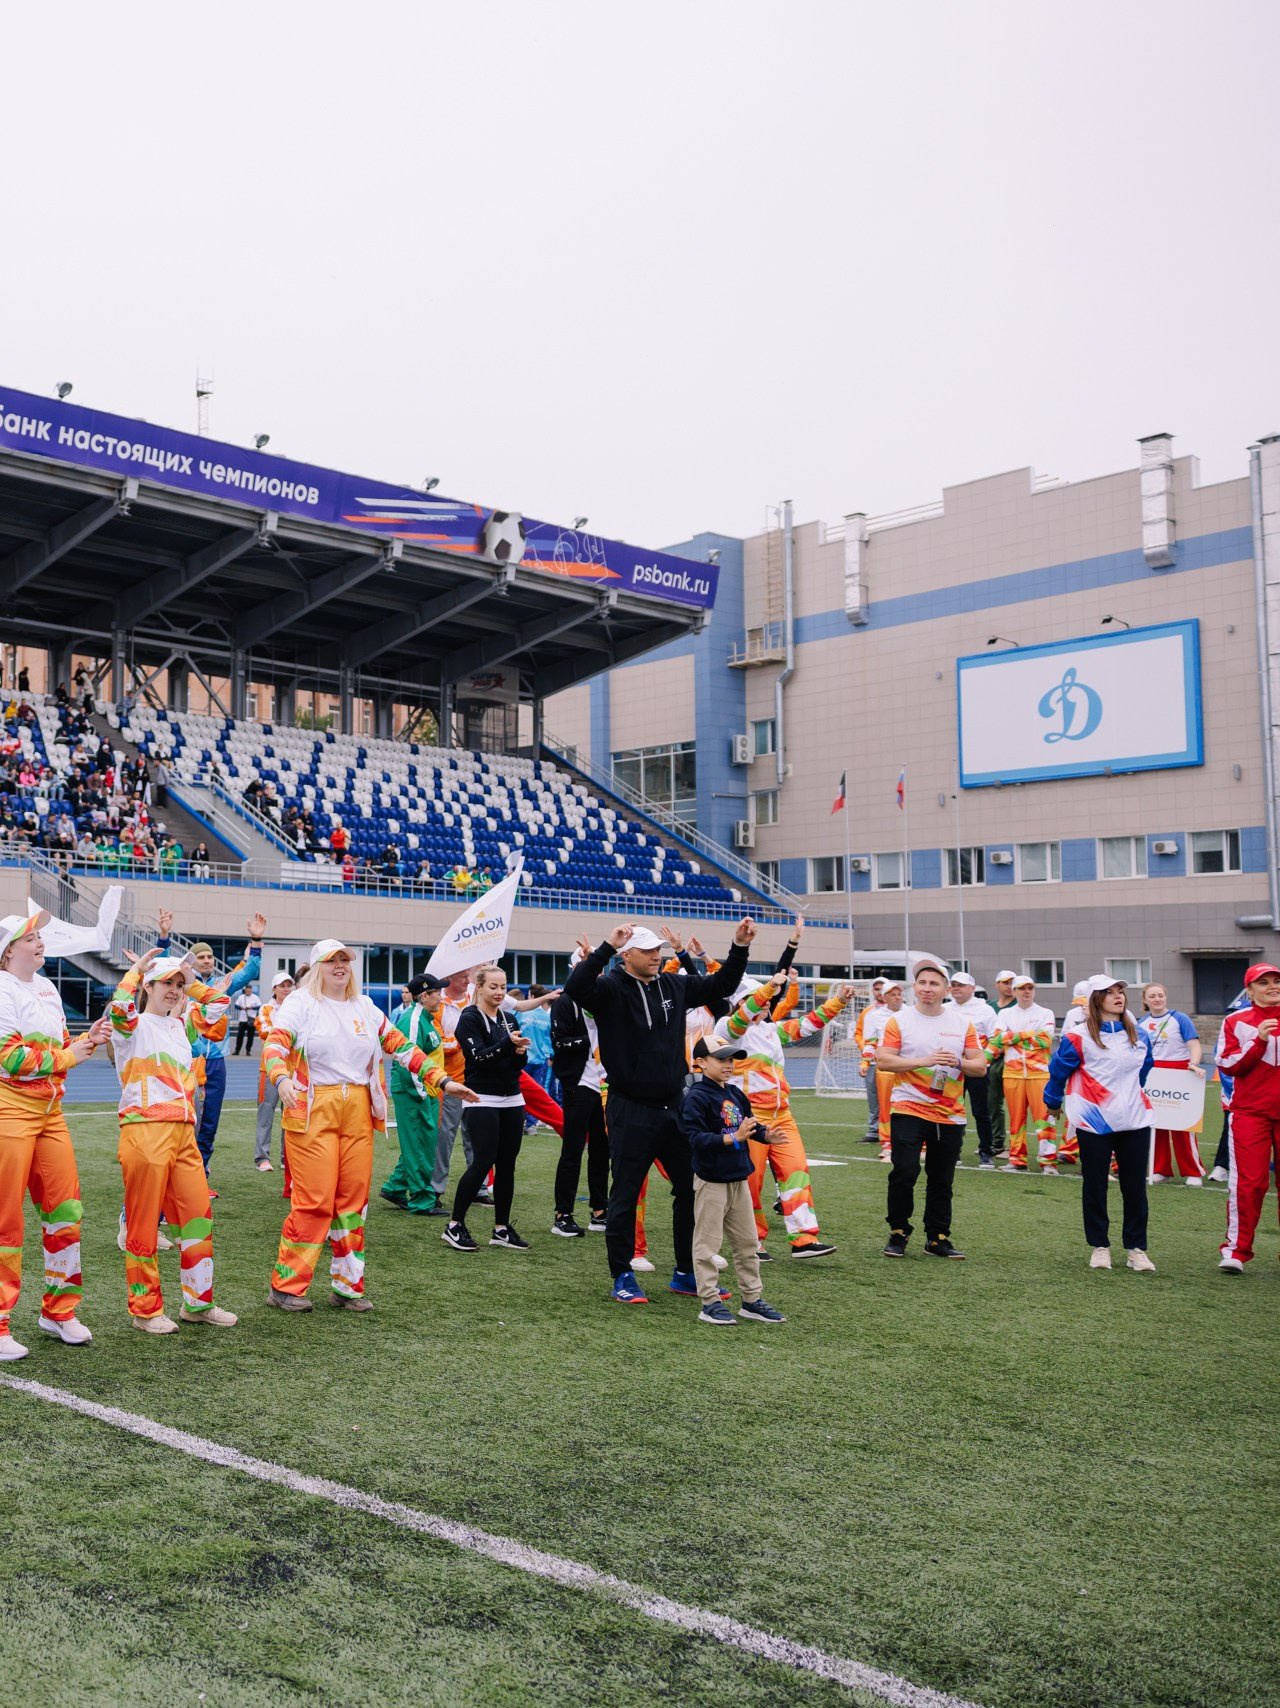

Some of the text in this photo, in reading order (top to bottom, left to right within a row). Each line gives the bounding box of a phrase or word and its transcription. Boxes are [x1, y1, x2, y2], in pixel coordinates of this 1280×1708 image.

[58, 425, 193, 476] настоящих
[199, 460, 320, 506] чемпионов
[632, 563, 710, 595] psbank.ru
[1144, 1088, 1190, 1101] КОМОС
